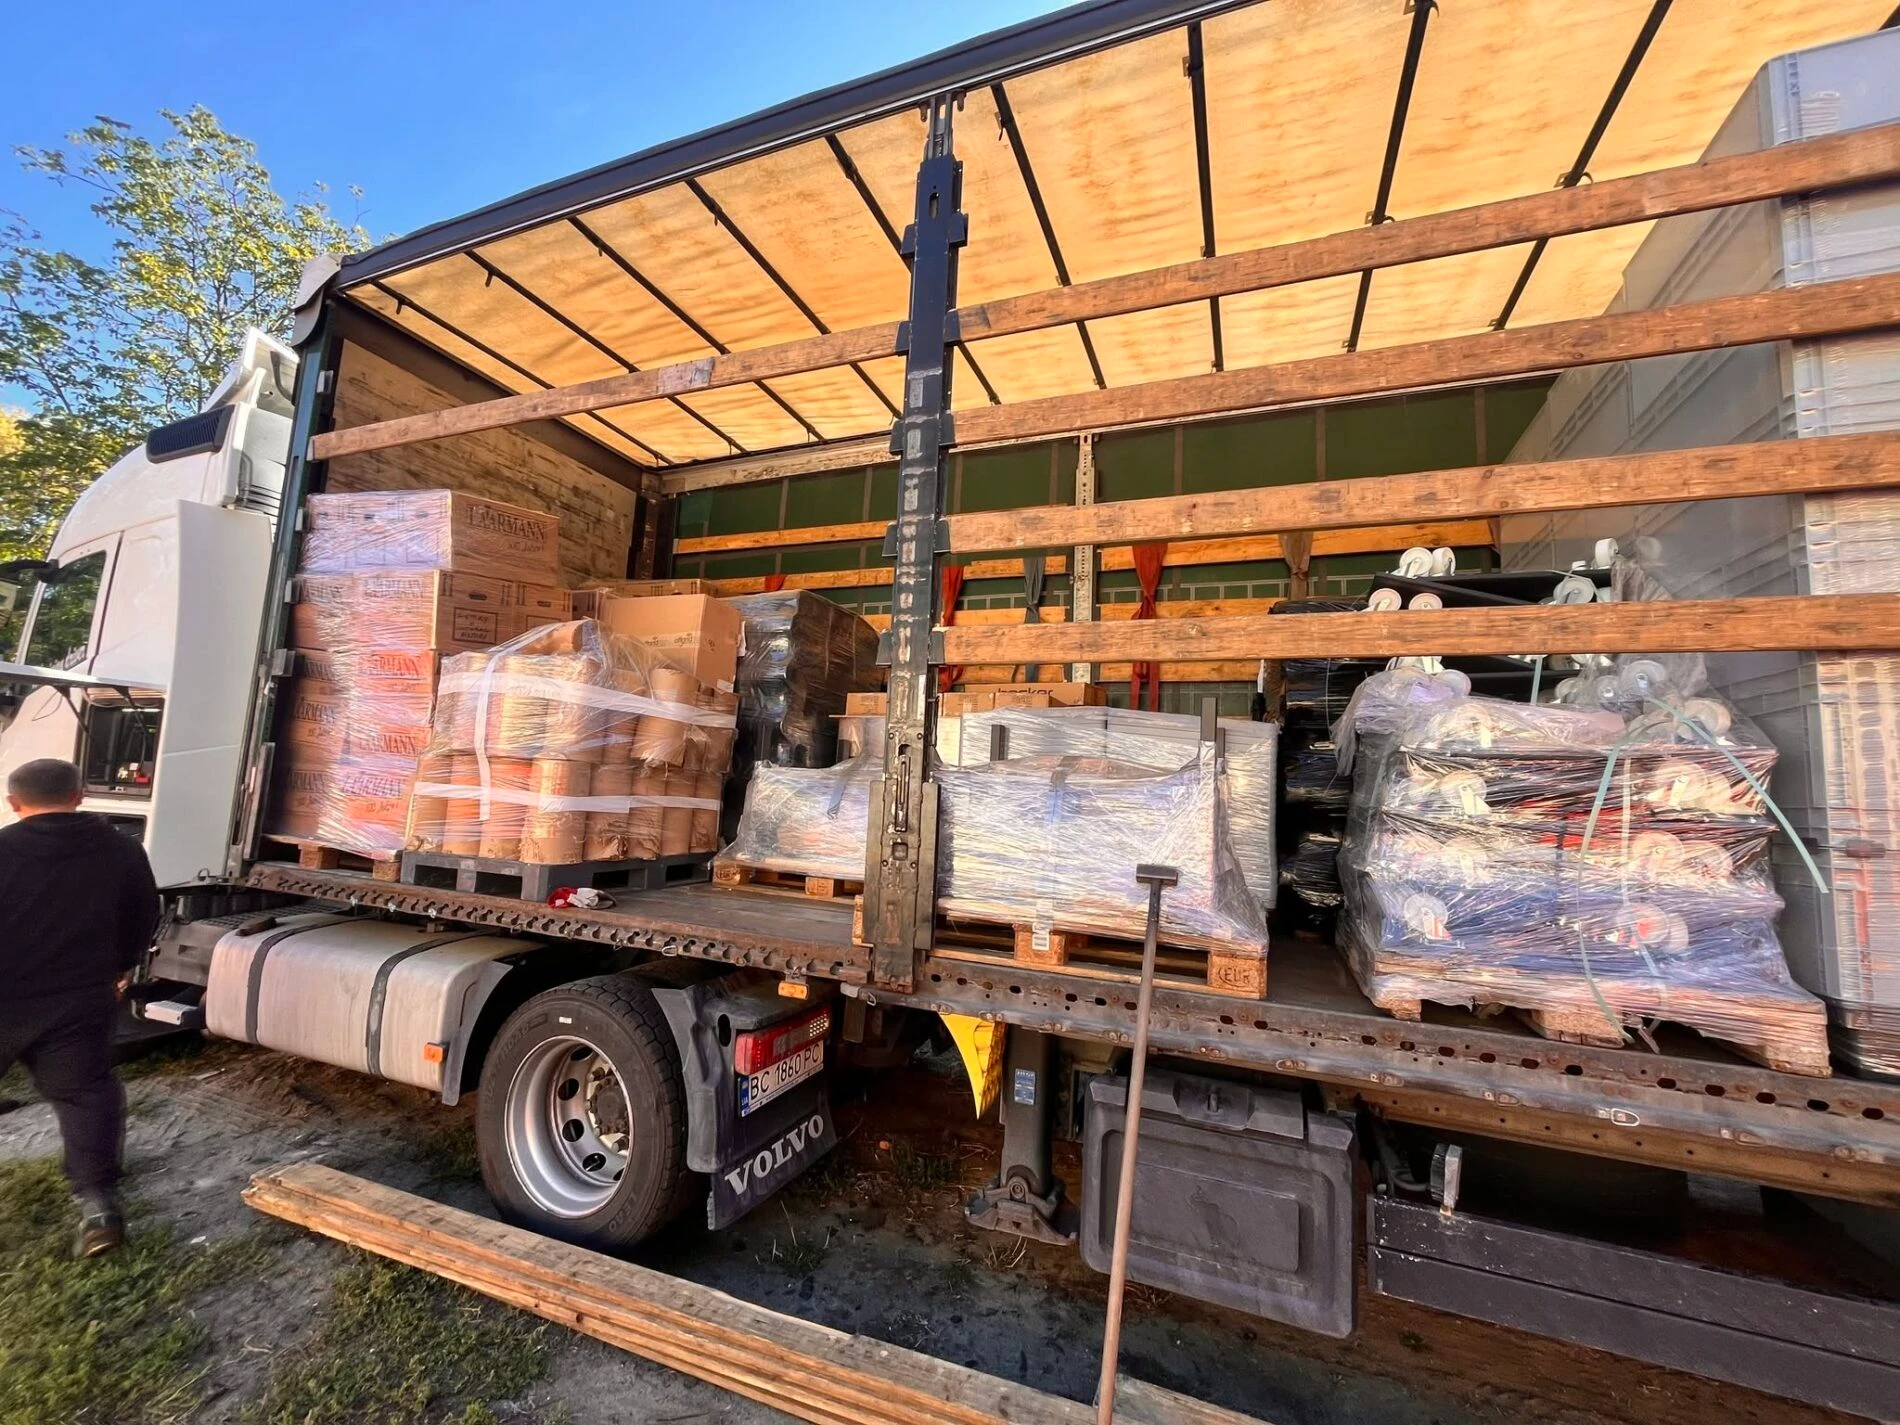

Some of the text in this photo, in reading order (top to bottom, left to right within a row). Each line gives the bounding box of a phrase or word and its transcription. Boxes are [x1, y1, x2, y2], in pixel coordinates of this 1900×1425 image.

[750, 1071, 770, 1100] BC
[774, 1053, 802, 1085] 1860
[803, 1043, 820, 1069] PC
[724, 1114, 824, 1196] VOLVO
